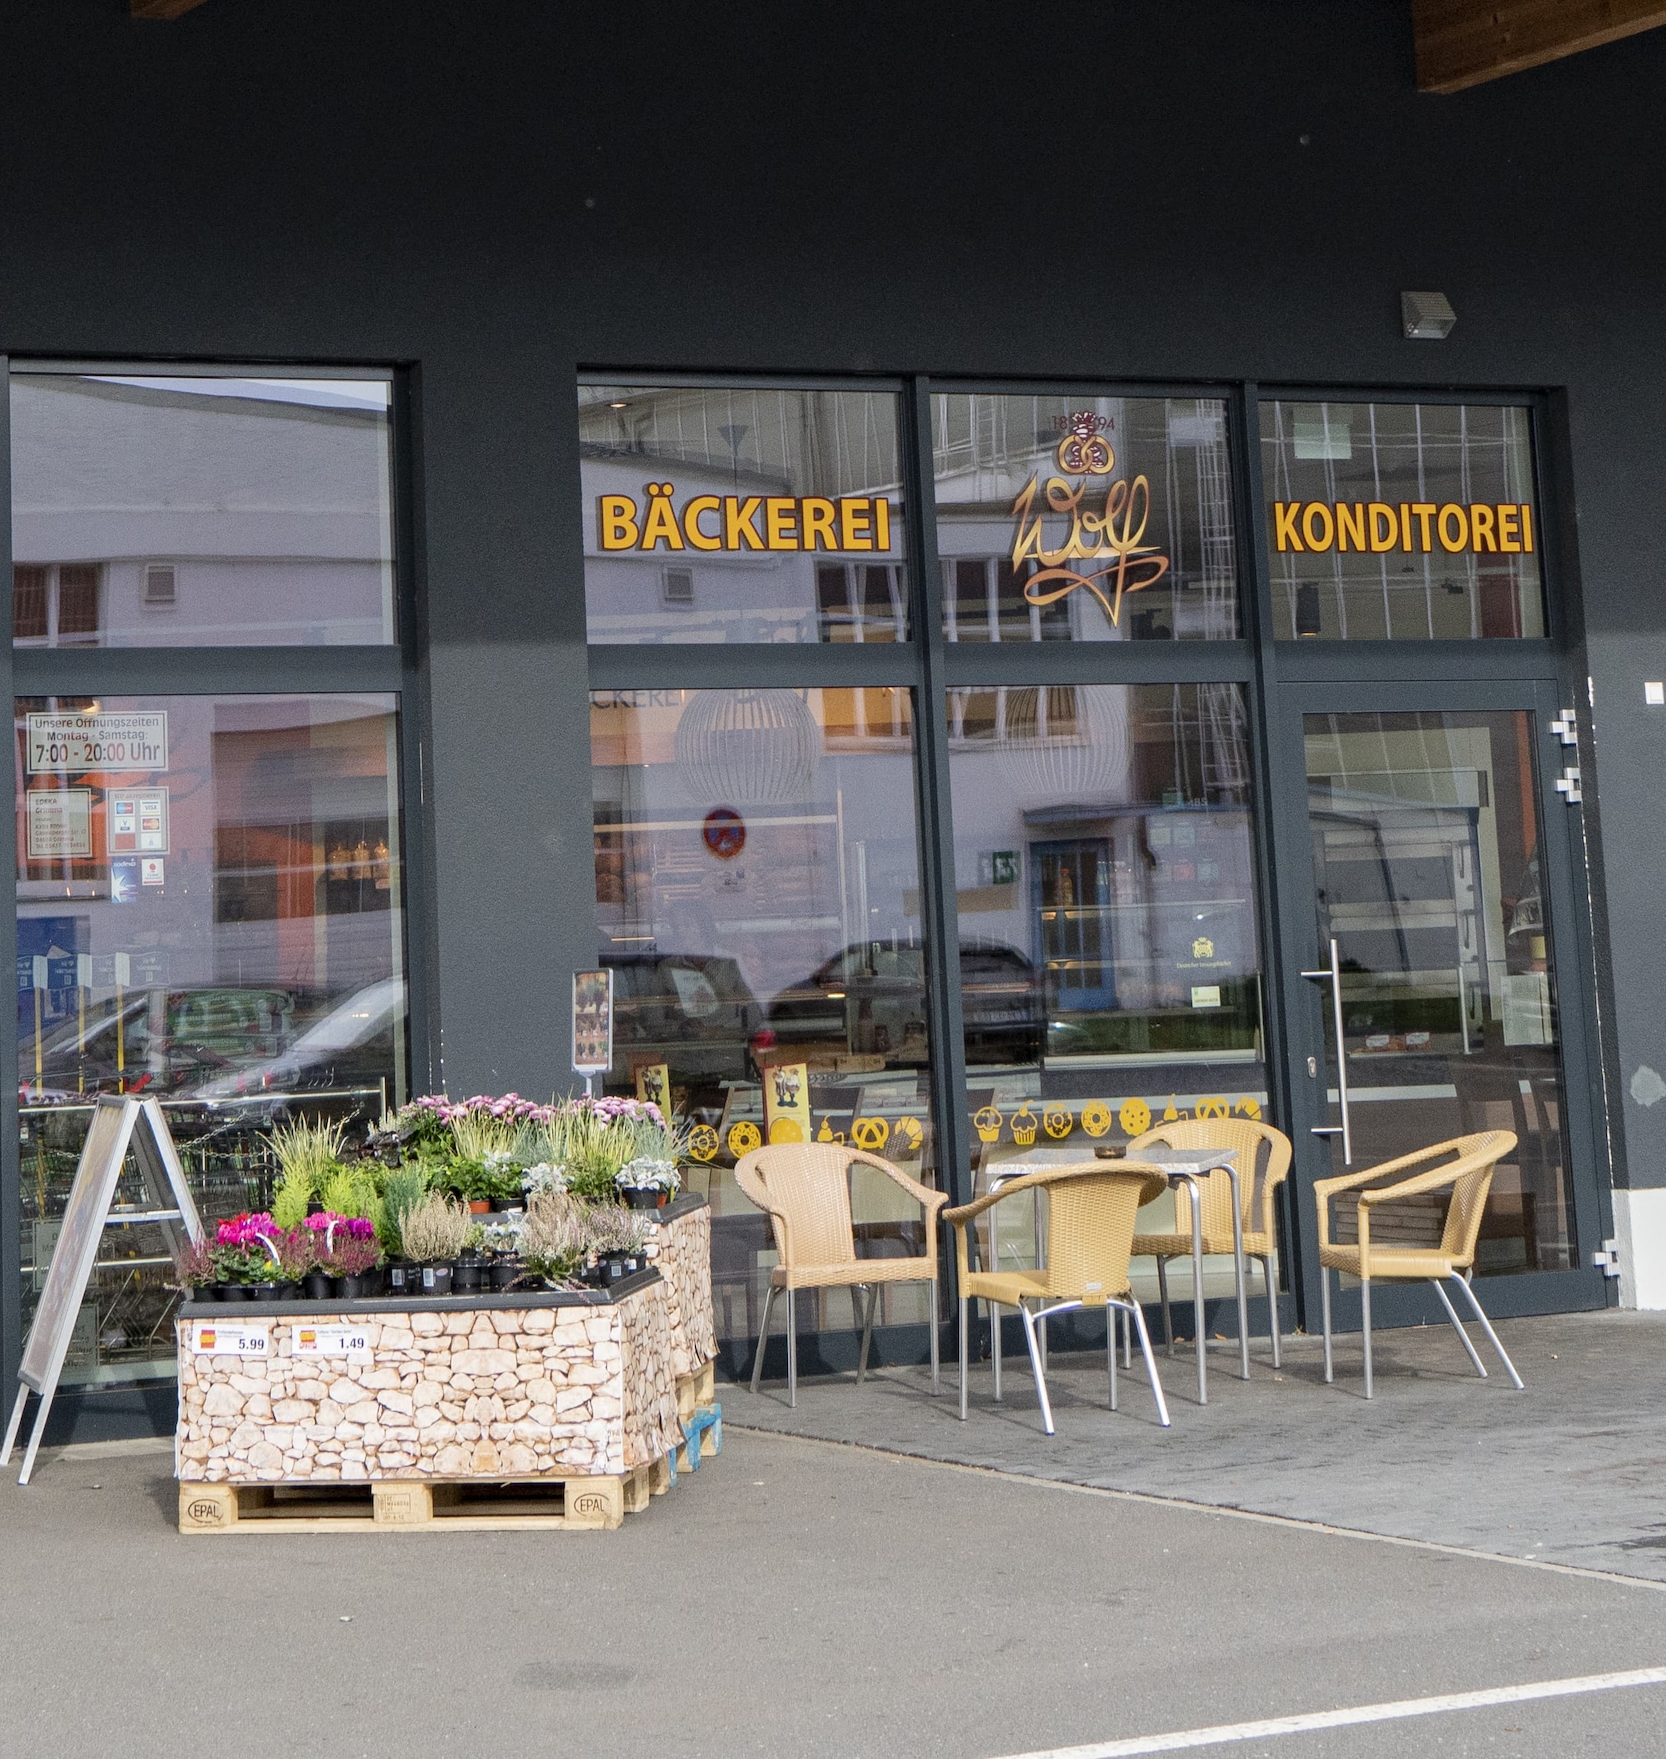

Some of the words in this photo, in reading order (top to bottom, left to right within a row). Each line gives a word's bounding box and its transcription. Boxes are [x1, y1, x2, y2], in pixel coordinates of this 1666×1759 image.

[598, 483, 891, 552] BÄCKEREI
[1273, 500, 1535, 555] KONDITOREI
[1012, 470, 1169, 627] Wolf
[35, 719, 73, 728] Unsere
[76, 717, 159, 729] Öffnungszeiten
[47, 731, 89, 741] Montag
[99, 730, 148, 740] Samstag:
[36, 743, 69, 763] 7:00
[84, 742, 126, 763] 20:00
[130, 742, 161, 761] Uhr
[239, 1338, 265, 1350] 5.99
[339, 1338, 365, 1349] 1.49
[194, 1504, 219, 1518] EPAL
[580, 1498, 605, 1512] EPAL
